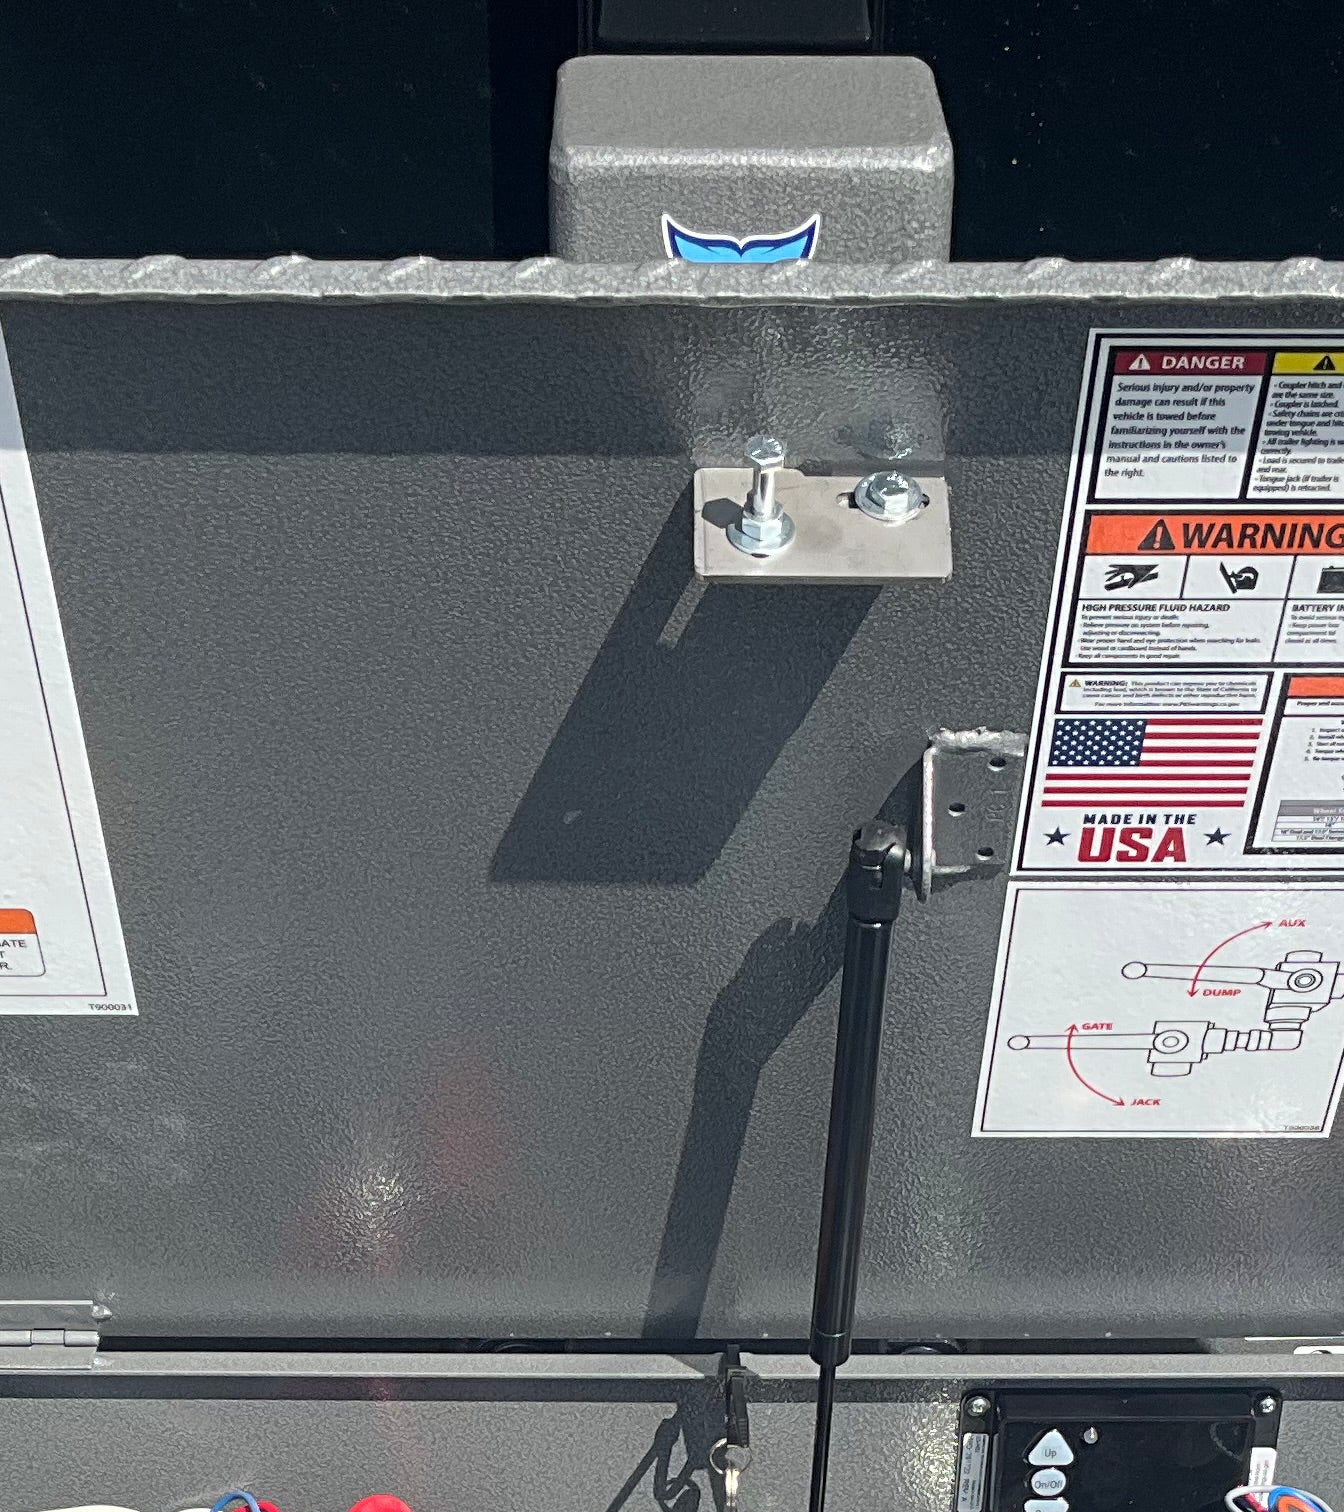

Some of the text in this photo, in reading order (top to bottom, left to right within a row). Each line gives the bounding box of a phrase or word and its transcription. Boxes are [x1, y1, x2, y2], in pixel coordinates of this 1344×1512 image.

[1161, 355, 1245, 370] DANGER
[1116, 381, 1256, 395] Serious injury and/or property
[1112, 410, 1217, 421] vehicle is towed before
[1103, 467, 1145, 479] the right.
[1081, 603, 1231, 612] HIGH PRESSURE FLUID HAZARD
[1291, 603, 1336, 613] BATTERY
[1082, 813, 1197, 825] MADE IN THE
[1078, 826, 1187, 863] USA
[1277, 918, 1306, 927] AUX
[1201, 988, 1242, 997] DUMP
[87, 1002, 132, 1011] T900031
[1081, 1022, 1113, 1031] GATE
[1130, 1098, 1161, 1106] JACK
[1045, 1449, 1057, 1459] Up
[1034, 1480, 1063, 1489] On/Off
